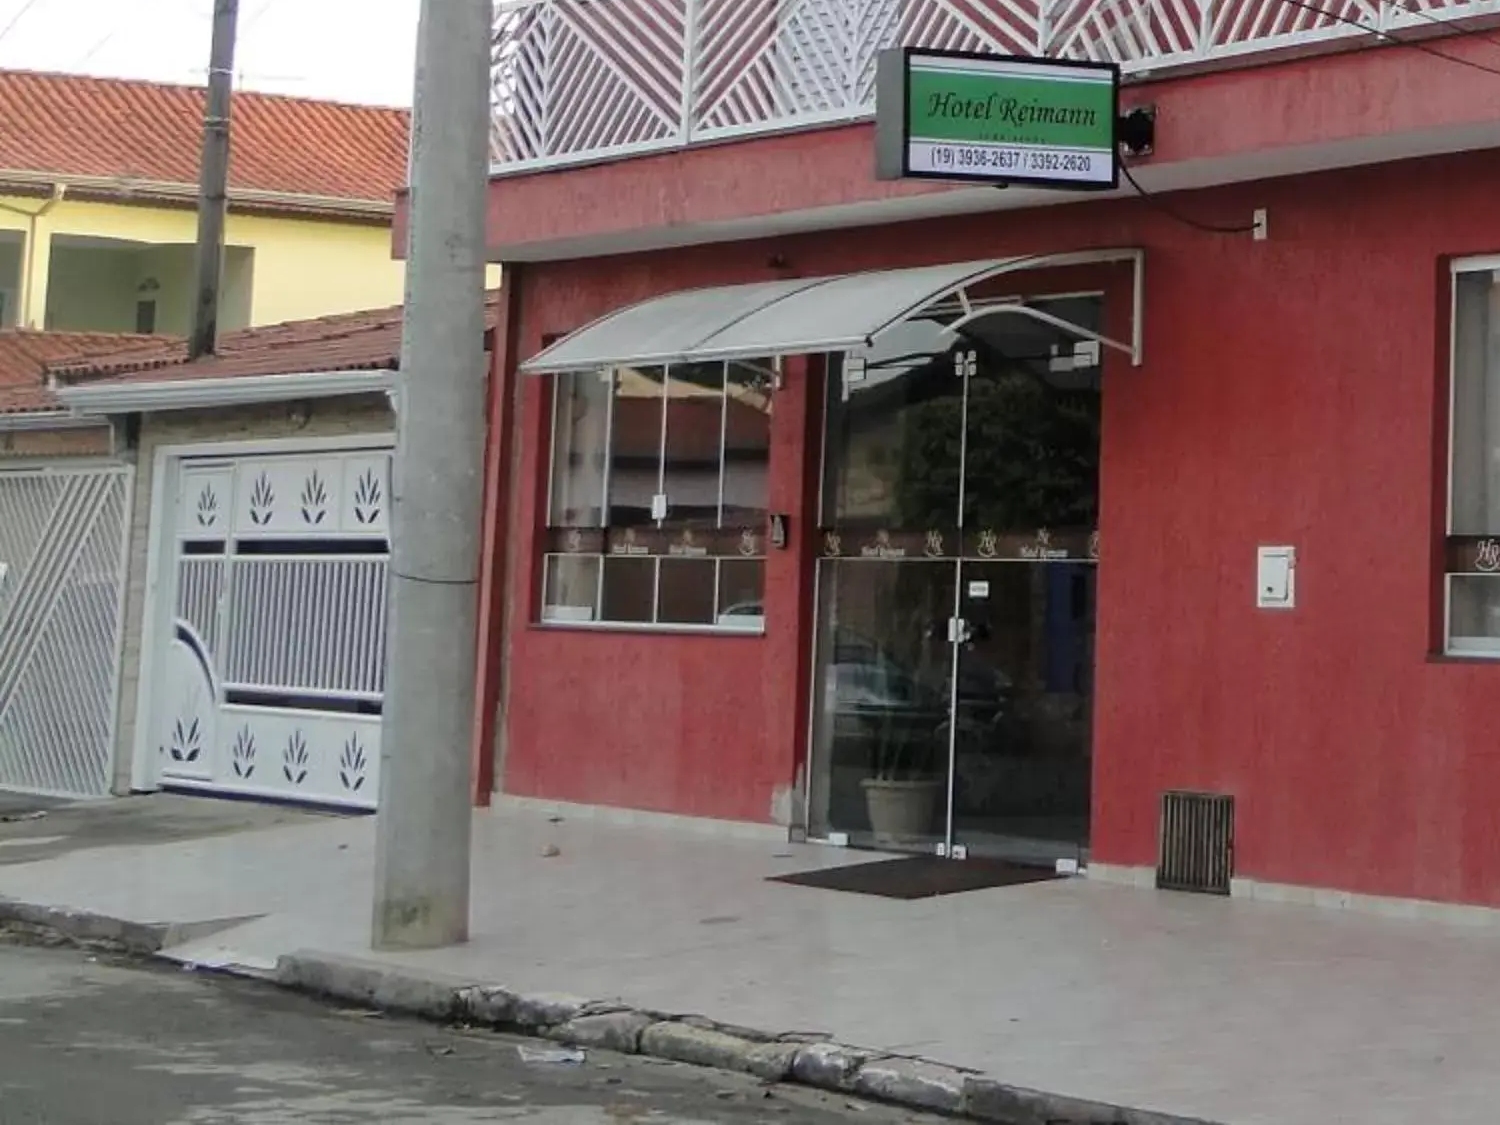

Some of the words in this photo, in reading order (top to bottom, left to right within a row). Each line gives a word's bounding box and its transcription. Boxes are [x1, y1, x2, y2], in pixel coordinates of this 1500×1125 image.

[928, 91, 997, 121] Hotel
[999, 97, 1096, 126] Reimann
[931, 148, 955, 168] (19)
[958, 149, 1021, 170] 3936-2637
